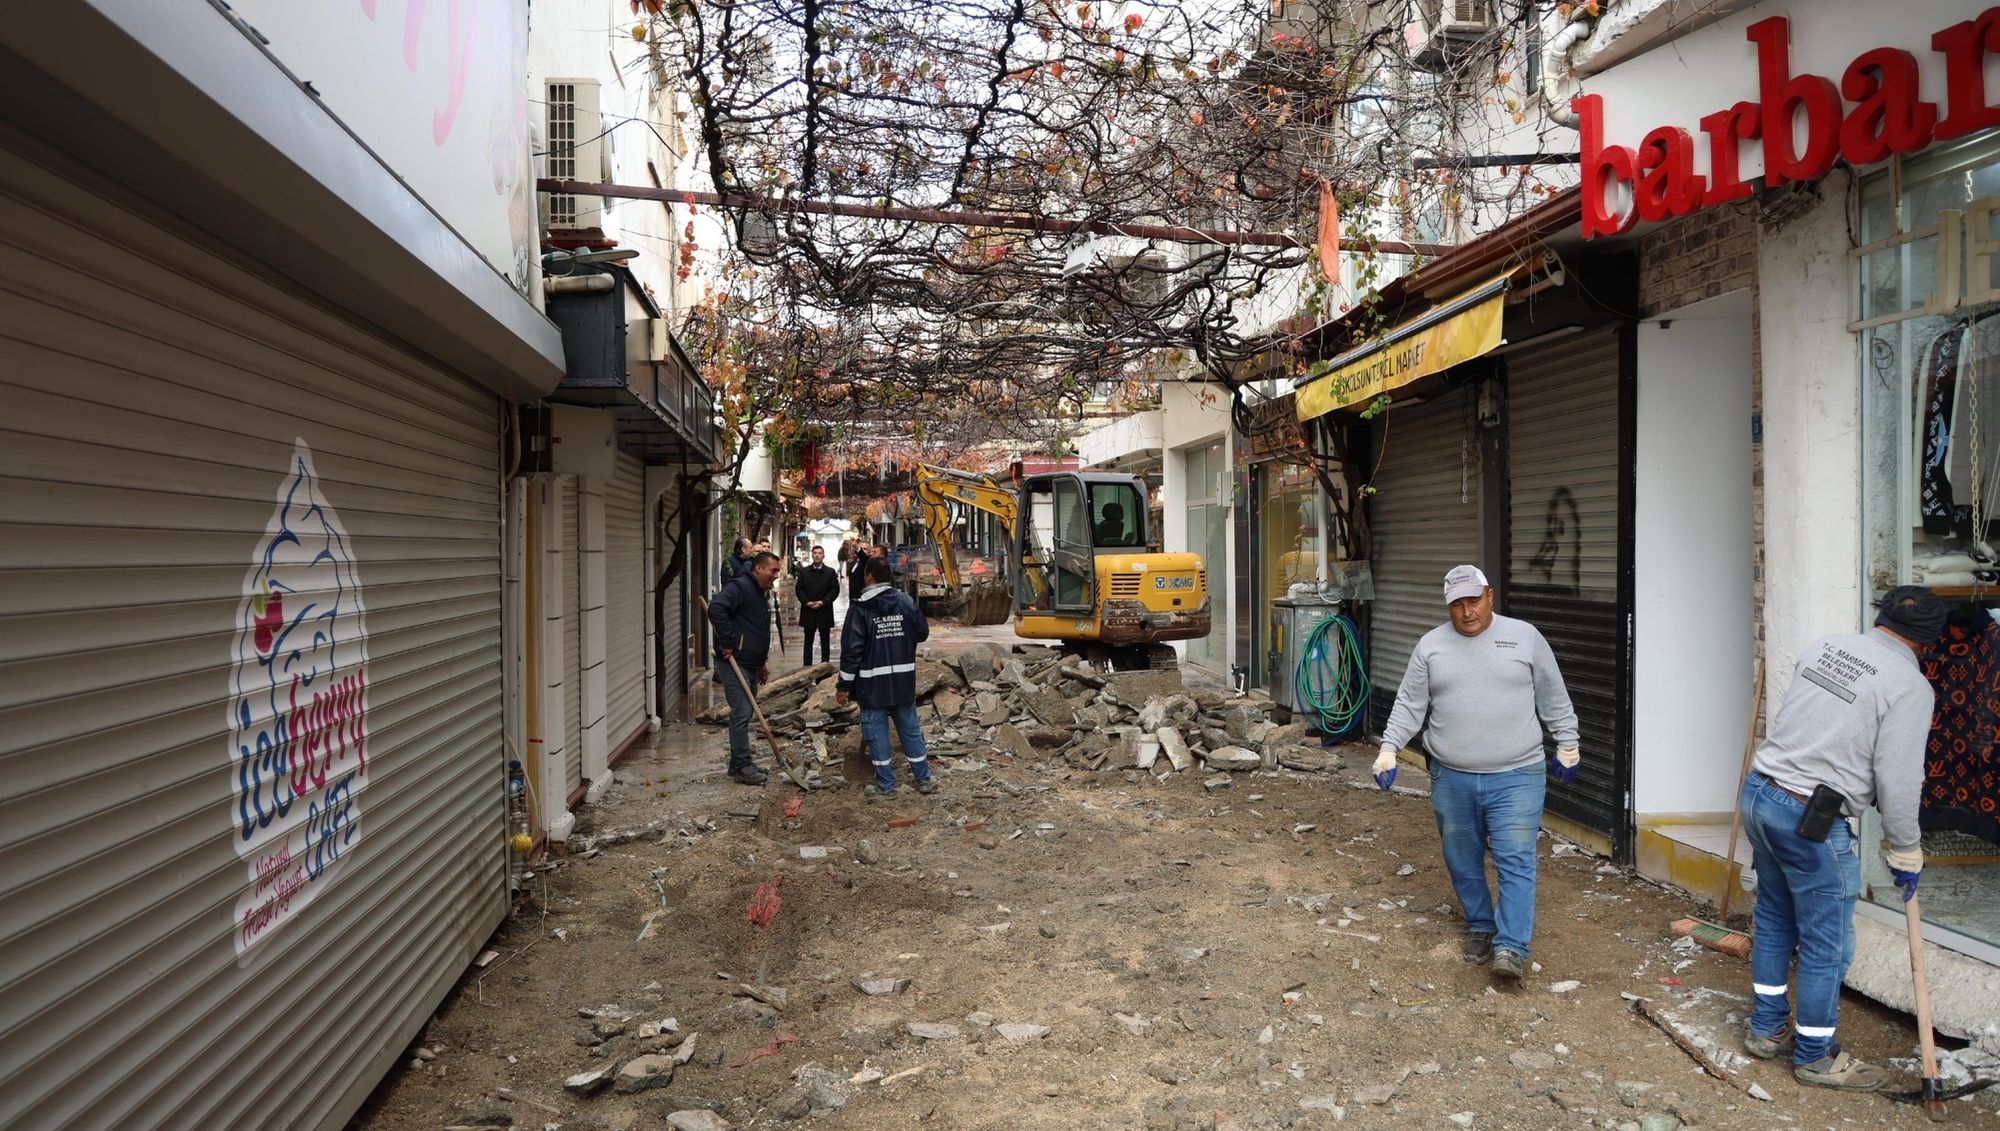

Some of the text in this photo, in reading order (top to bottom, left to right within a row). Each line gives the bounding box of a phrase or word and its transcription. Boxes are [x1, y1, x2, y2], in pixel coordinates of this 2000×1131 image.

[1396, 341, 1426, 375] MARKET
[1167, 577, 1193, 588] XCMG
[305, 769, 356, 882] CAFE
